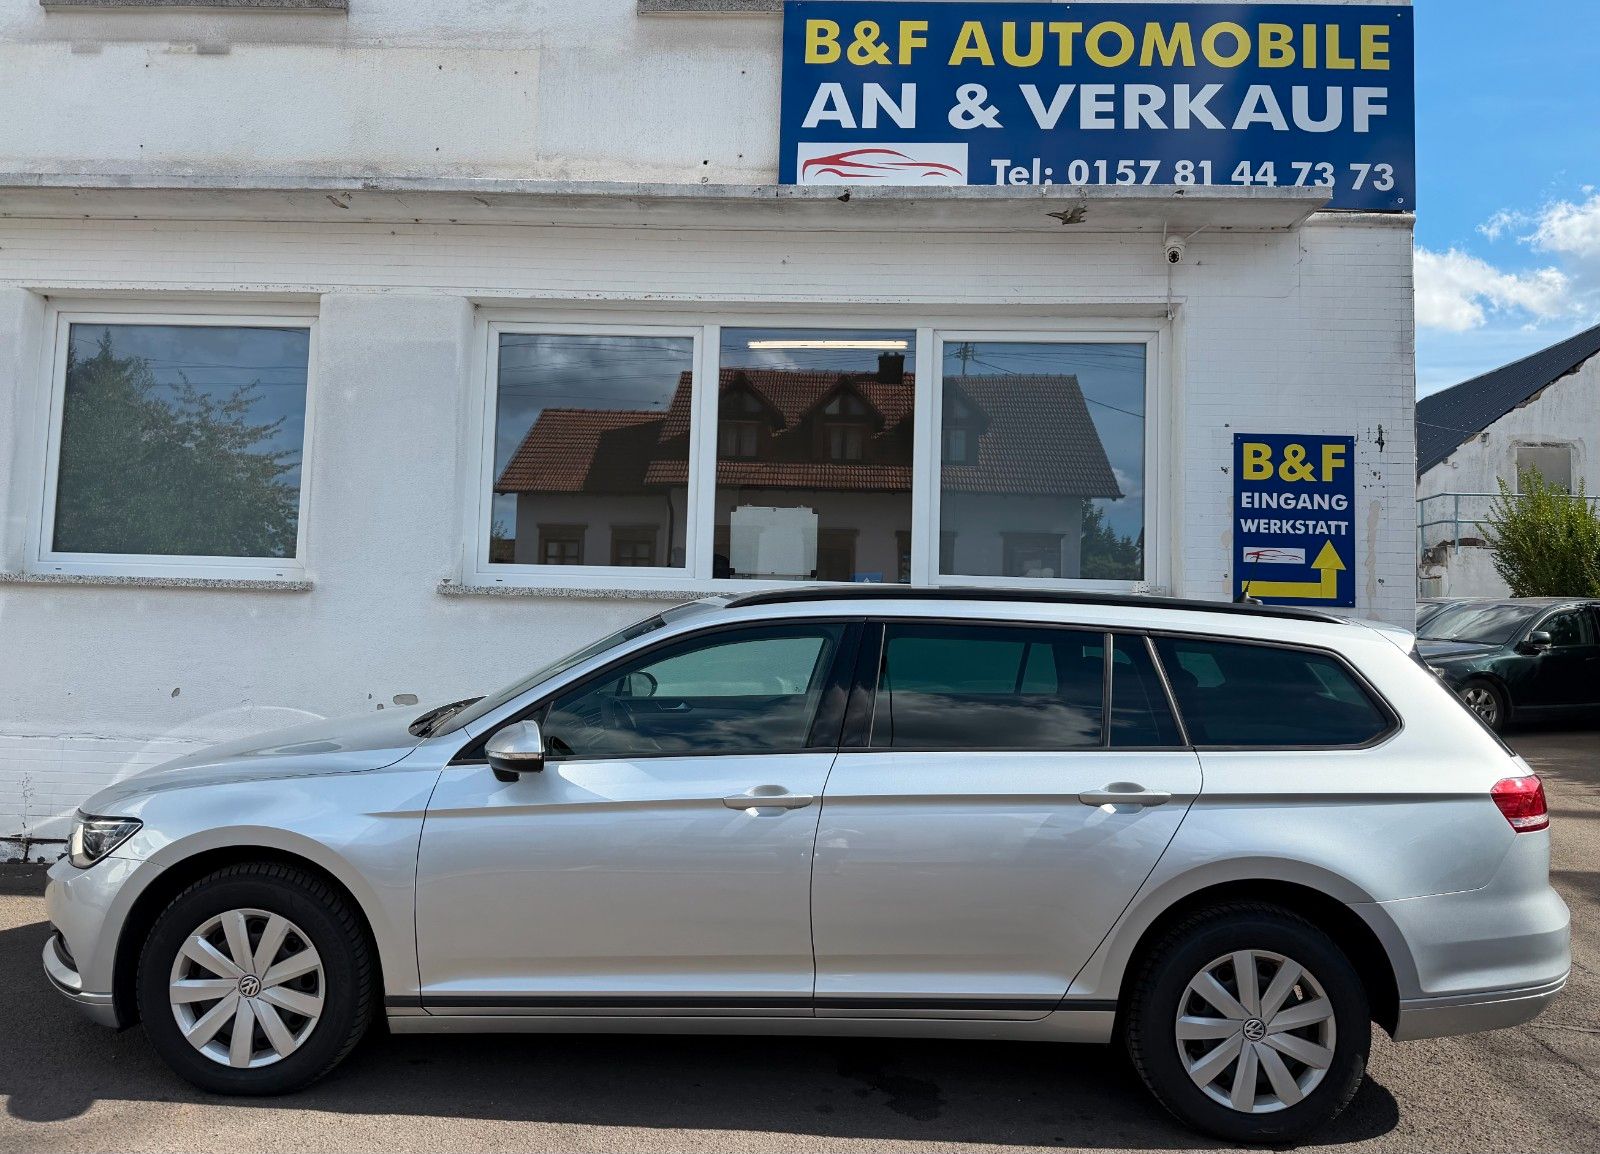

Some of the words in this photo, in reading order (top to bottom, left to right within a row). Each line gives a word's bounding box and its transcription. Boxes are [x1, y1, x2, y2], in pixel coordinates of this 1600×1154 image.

[803, 19, 929, 66] B&F
[947, 20, 1391, 70] AUTOMOBILE
[800, 81, 918, 130] AN
[946, 83, 1004, 130] &
[1018, 84, 1388, 133] VERKAUF
[990, 157, 1054, 185] Tel:
[1067, 159, 1161, 185] 0157
[1173, 160, 1212, 185] 81
[1231, 160, 1277, 187] 44
[1291, 161, 1336, 187] 73
[1349, 162, 1395, 192] 73
[1242, 442, 1346, 482] B&F
[1241, 491, 1349, 511] EINGANG
[1240, 518, 1349, 536] WERKSTATT
